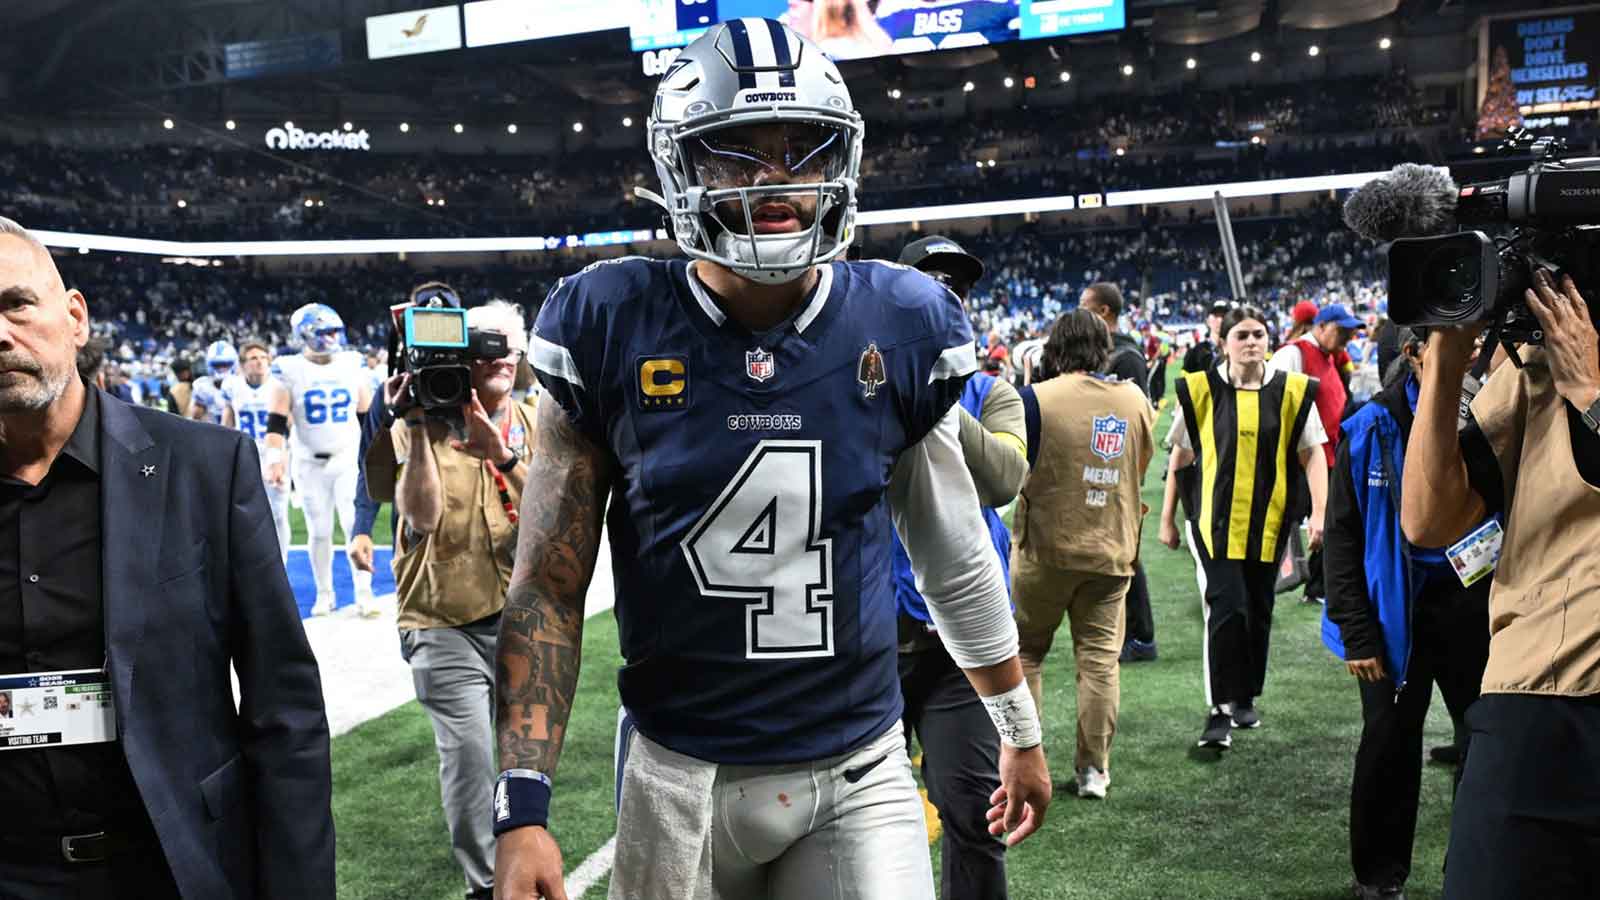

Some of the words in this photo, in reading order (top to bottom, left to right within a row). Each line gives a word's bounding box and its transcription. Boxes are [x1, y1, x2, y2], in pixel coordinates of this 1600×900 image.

[912, 8, 964, 36] BASS
[1510, 62, 1589, 83] HEMSELVES
[745, 92, 796, 103] COWBOYS
[288, 128, 371, 151] Rocket
[640, 359, 685, 396] C
[750, 361, 770, 377] NFL
[304, 388, 352, 424] 62
[728, 415, 801, 430] COWBOYS
[1096, 432, 1121, 454] NFL
[1083, 465, 1119, 485] MEDIA
[680, 440, 834, 659] 4
[8, 736, 32, 746] VISITING
[33, 734, 48, 744] TEAM
[495, 779, 511, 823] 4
